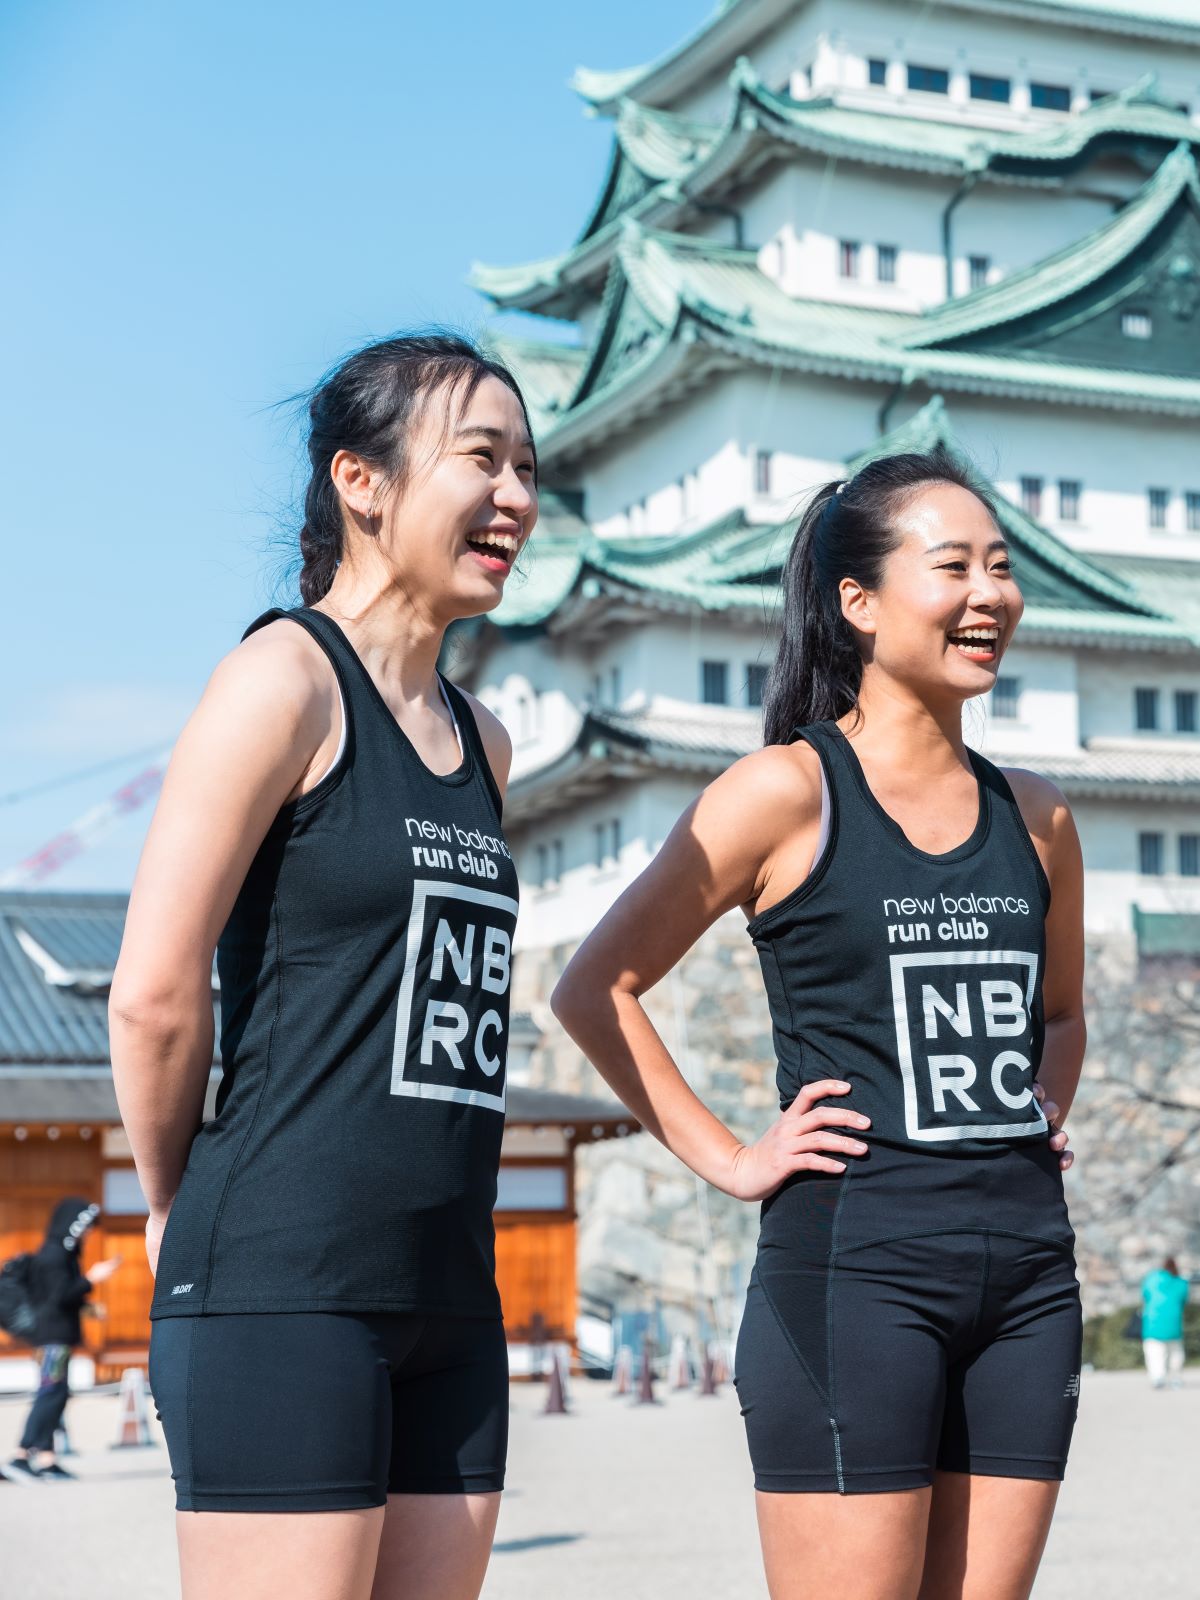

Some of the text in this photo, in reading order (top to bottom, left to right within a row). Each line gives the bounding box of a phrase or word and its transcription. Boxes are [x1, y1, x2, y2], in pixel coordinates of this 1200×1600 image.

[404, 817, 511, 859] new balanc
[411, 846, 499, 880] run club
[883, 892, 1030, 917] new balance
[887, 916, 989, 943] run club
[921, 980, 1027, 1039] NB
[927, 1050, 1034, 1113] RC
